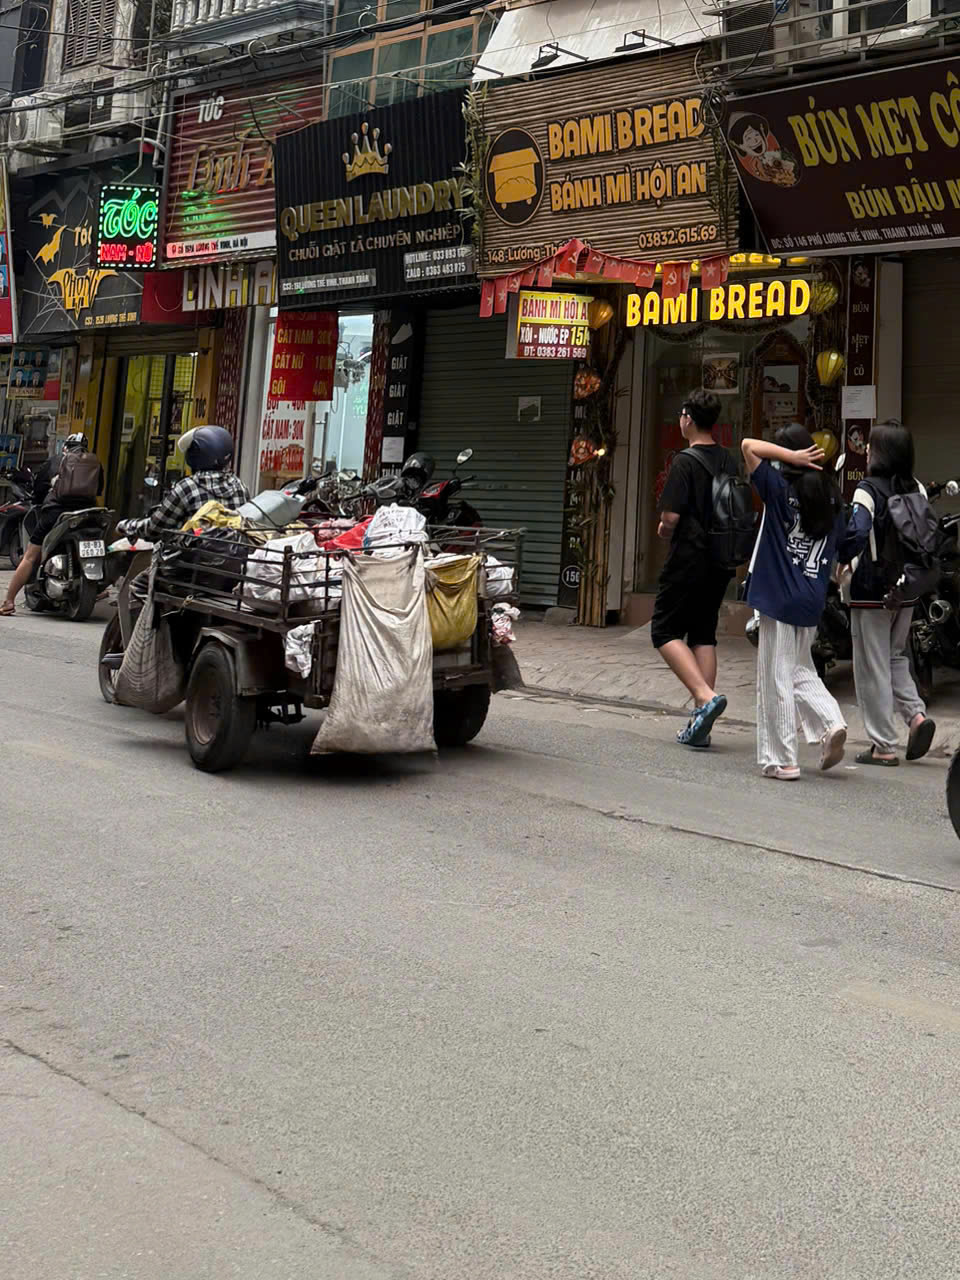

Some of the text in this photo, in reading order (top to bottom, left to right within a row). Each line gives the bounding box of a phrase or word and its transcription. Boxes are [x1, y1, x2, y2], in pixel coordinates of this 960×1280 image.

[548, 98, 705, 160] BAMI BREAD
[788, 96, 862, 168] BÚN
[856, 94, 932, 171] MẸT
[551, 161, 707, 212] BÁNH MÌ HỘI AN
[845, 181, 897, 220] BÚN
[899, 176, 946, 220] ĐẬU
[280, 176, 465, 241] QUEEN LAUNDRY
[638, 224, 717, 249] 03832.615.69
[882, 227, 908, 240] THANH
[931, 222, 946, 235] HN
[487, 248, 505, 264] 148
[521, 295, 579, 324] BÁNH MÌ HỘI
[626, 279, 811, 327] BAMI BREAD
[852, 301, 870, 314] BÚN
[519, 323, 533, 344] XÔI
[536, 346, 556, 358] 0383
[556, 347, 571, 358] 261
[572, 347, 587, 359] 569
